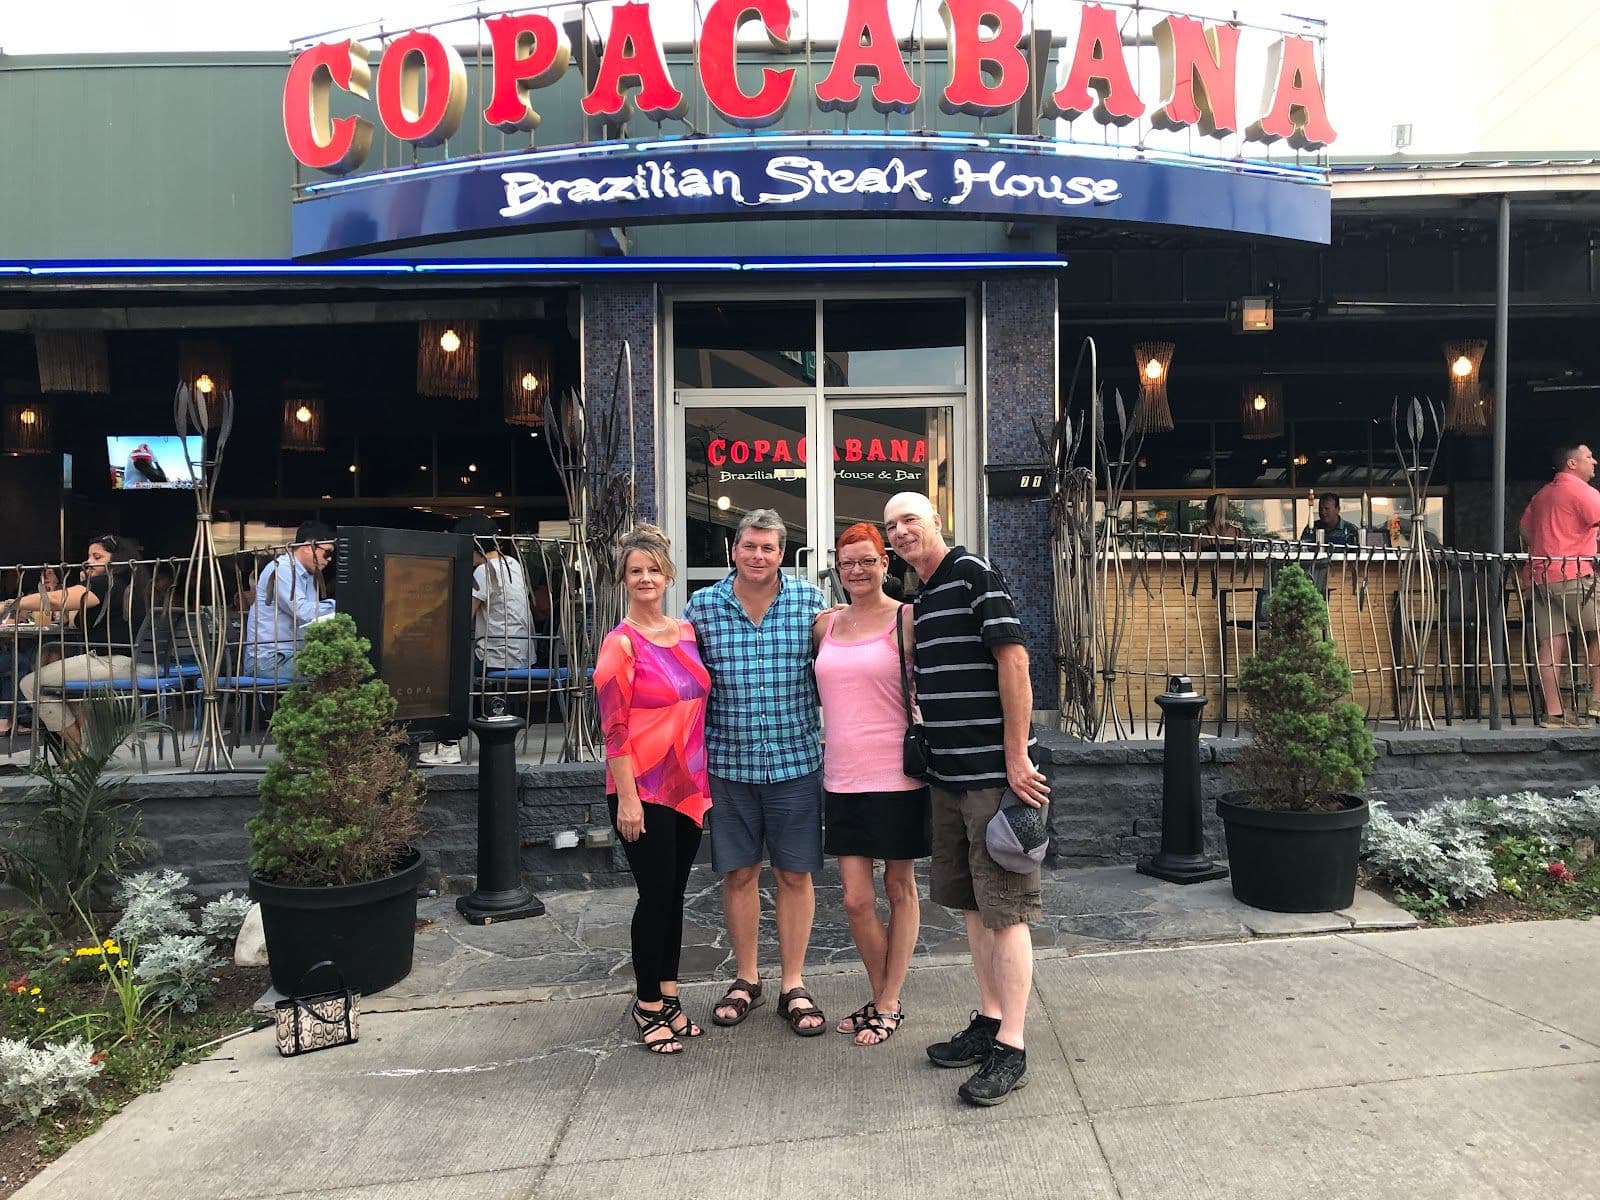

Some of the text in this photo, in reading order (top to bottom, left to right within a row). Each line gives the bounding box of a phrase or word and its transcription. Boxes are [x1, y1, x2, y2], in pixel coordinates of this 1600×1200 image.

[283, 0, 1337, 168] COPACABANA
[500, 156, 1122, 217] Brazilian Steak House
[878, 470, 891, 480] &
[895, 469, 921, 481] Bar
